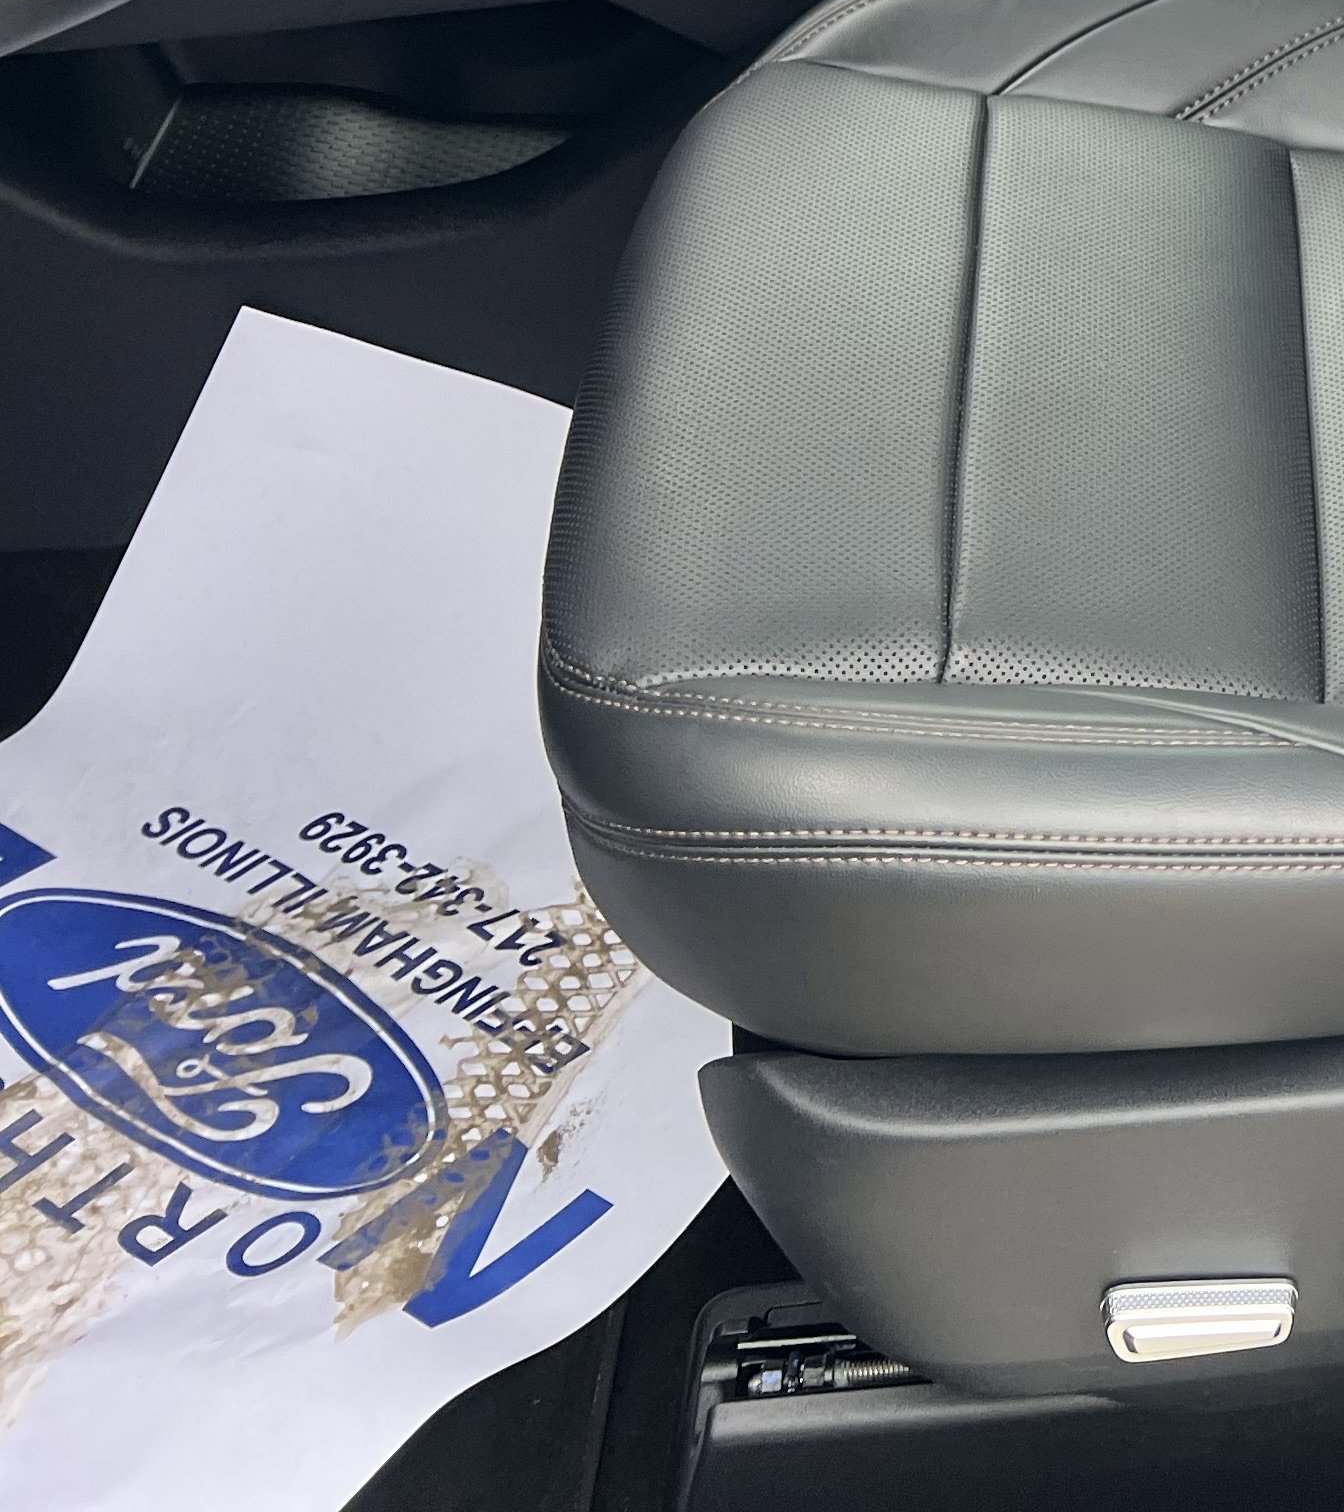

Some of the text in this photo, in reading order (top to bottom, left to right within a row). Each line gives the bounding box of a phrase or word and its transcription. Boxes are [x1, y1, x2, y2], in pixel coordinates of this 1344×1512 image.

[141, 807, 328, 915] ILLINOIS
[299, 812, 567, 966] 217-342-3929
[47, 934, 374, 1141] Ford
